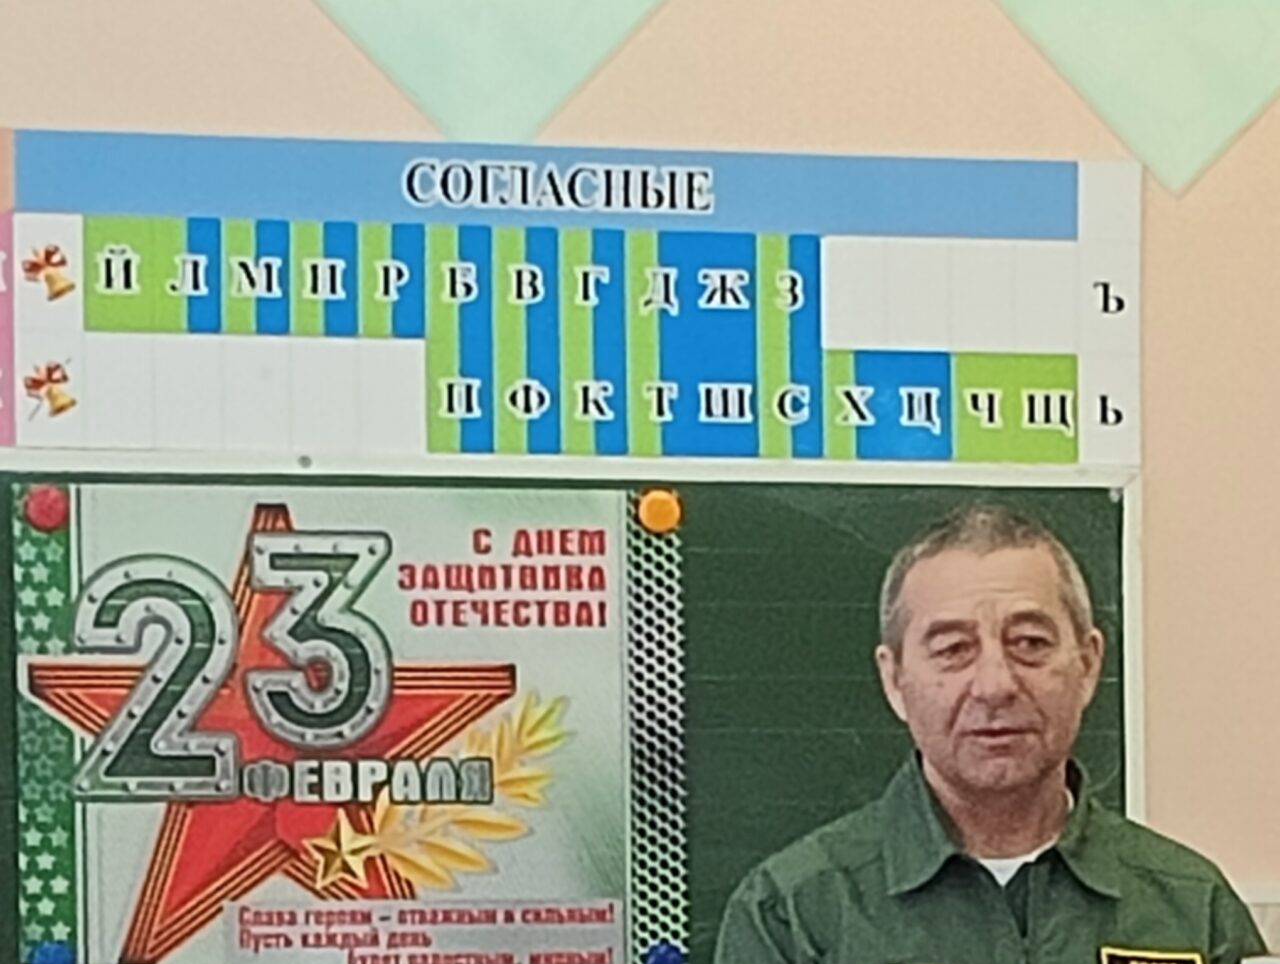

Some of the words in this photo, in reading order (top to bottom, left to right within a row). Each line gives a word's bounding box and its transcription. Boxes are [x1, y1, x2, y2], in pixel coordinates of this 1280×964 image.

[406, 159, 713, 212] СОГЛАСНЫЕ
[100, 247, 137, 291] Й
[169, 257, 205, 292] Л
[233, 259, 279, 294] М
[377, 263, 407, 298] Р
[444, 264, 475, 299] Б
[511, 266, 542, 301] В
[576, 269, 606, 301] Г
[643, 270, 675, 312] Д
[701, 272, 747, 306] Ж
[779, 274, 803, 309] З
[1093, 281, 1125, 314] Ъ
[508, 382, 547, 416] Ф
[577, 385, 610, 417] К
[648, 385, 676, 417] Т
[701, 385, 750, 419] Ш
[779, 388, 807, 420] С
[839, 389, 871, 422] Х
[902, 389, 939, 431] Ц
[966, 391, 999, 425] Ч
[1024, 391, 1072, 433] Щ
[1099, 396, 1123, 425] Ь
[472, 528, 492, 555] С
[512, 528, 606, 558] ДНЕМ
[398, 563, 606, 593] ЗАЩИТНИКА
[410, 599, 606, 628] ОТЕЧЕСТВА!
[75, 531, 394, 803] 23
[242, 758, 493, 804] ФЕВРАЛЯ
